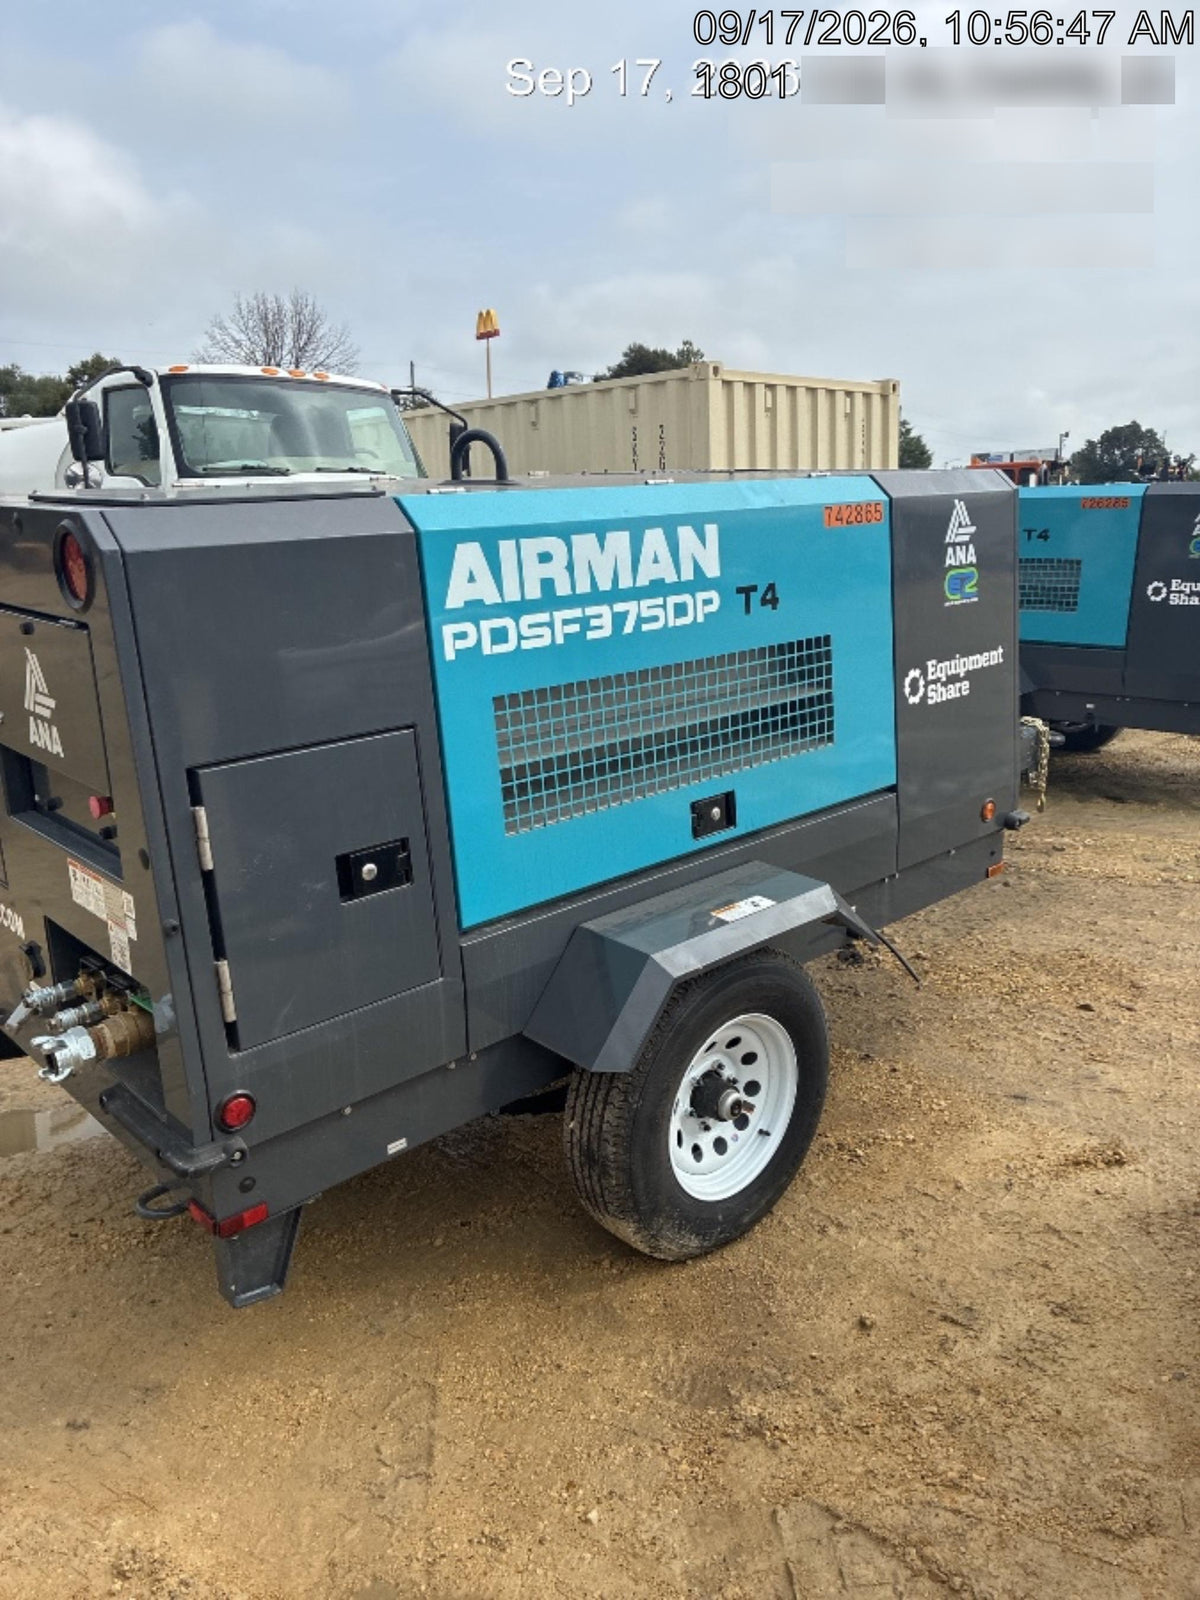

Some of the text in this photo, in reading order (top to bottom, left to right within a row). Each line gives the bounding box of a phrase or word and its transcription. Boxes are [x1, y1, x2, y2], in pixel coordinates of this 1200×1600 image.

[824, 502, 883, 527] 742865
[1022, 528, 1050, 541] T4
[445, 523, 721, 609] AIRMAN
[945, 543, 977, 567] ANA
[736, 582, 779, 616] T4
[442, 589, 721, 661] PDSF375DP
[926, 644, 1004, 682] Equipment
[927, 680, 970, 705] Share
[29, 715, 65, 758] ANA
